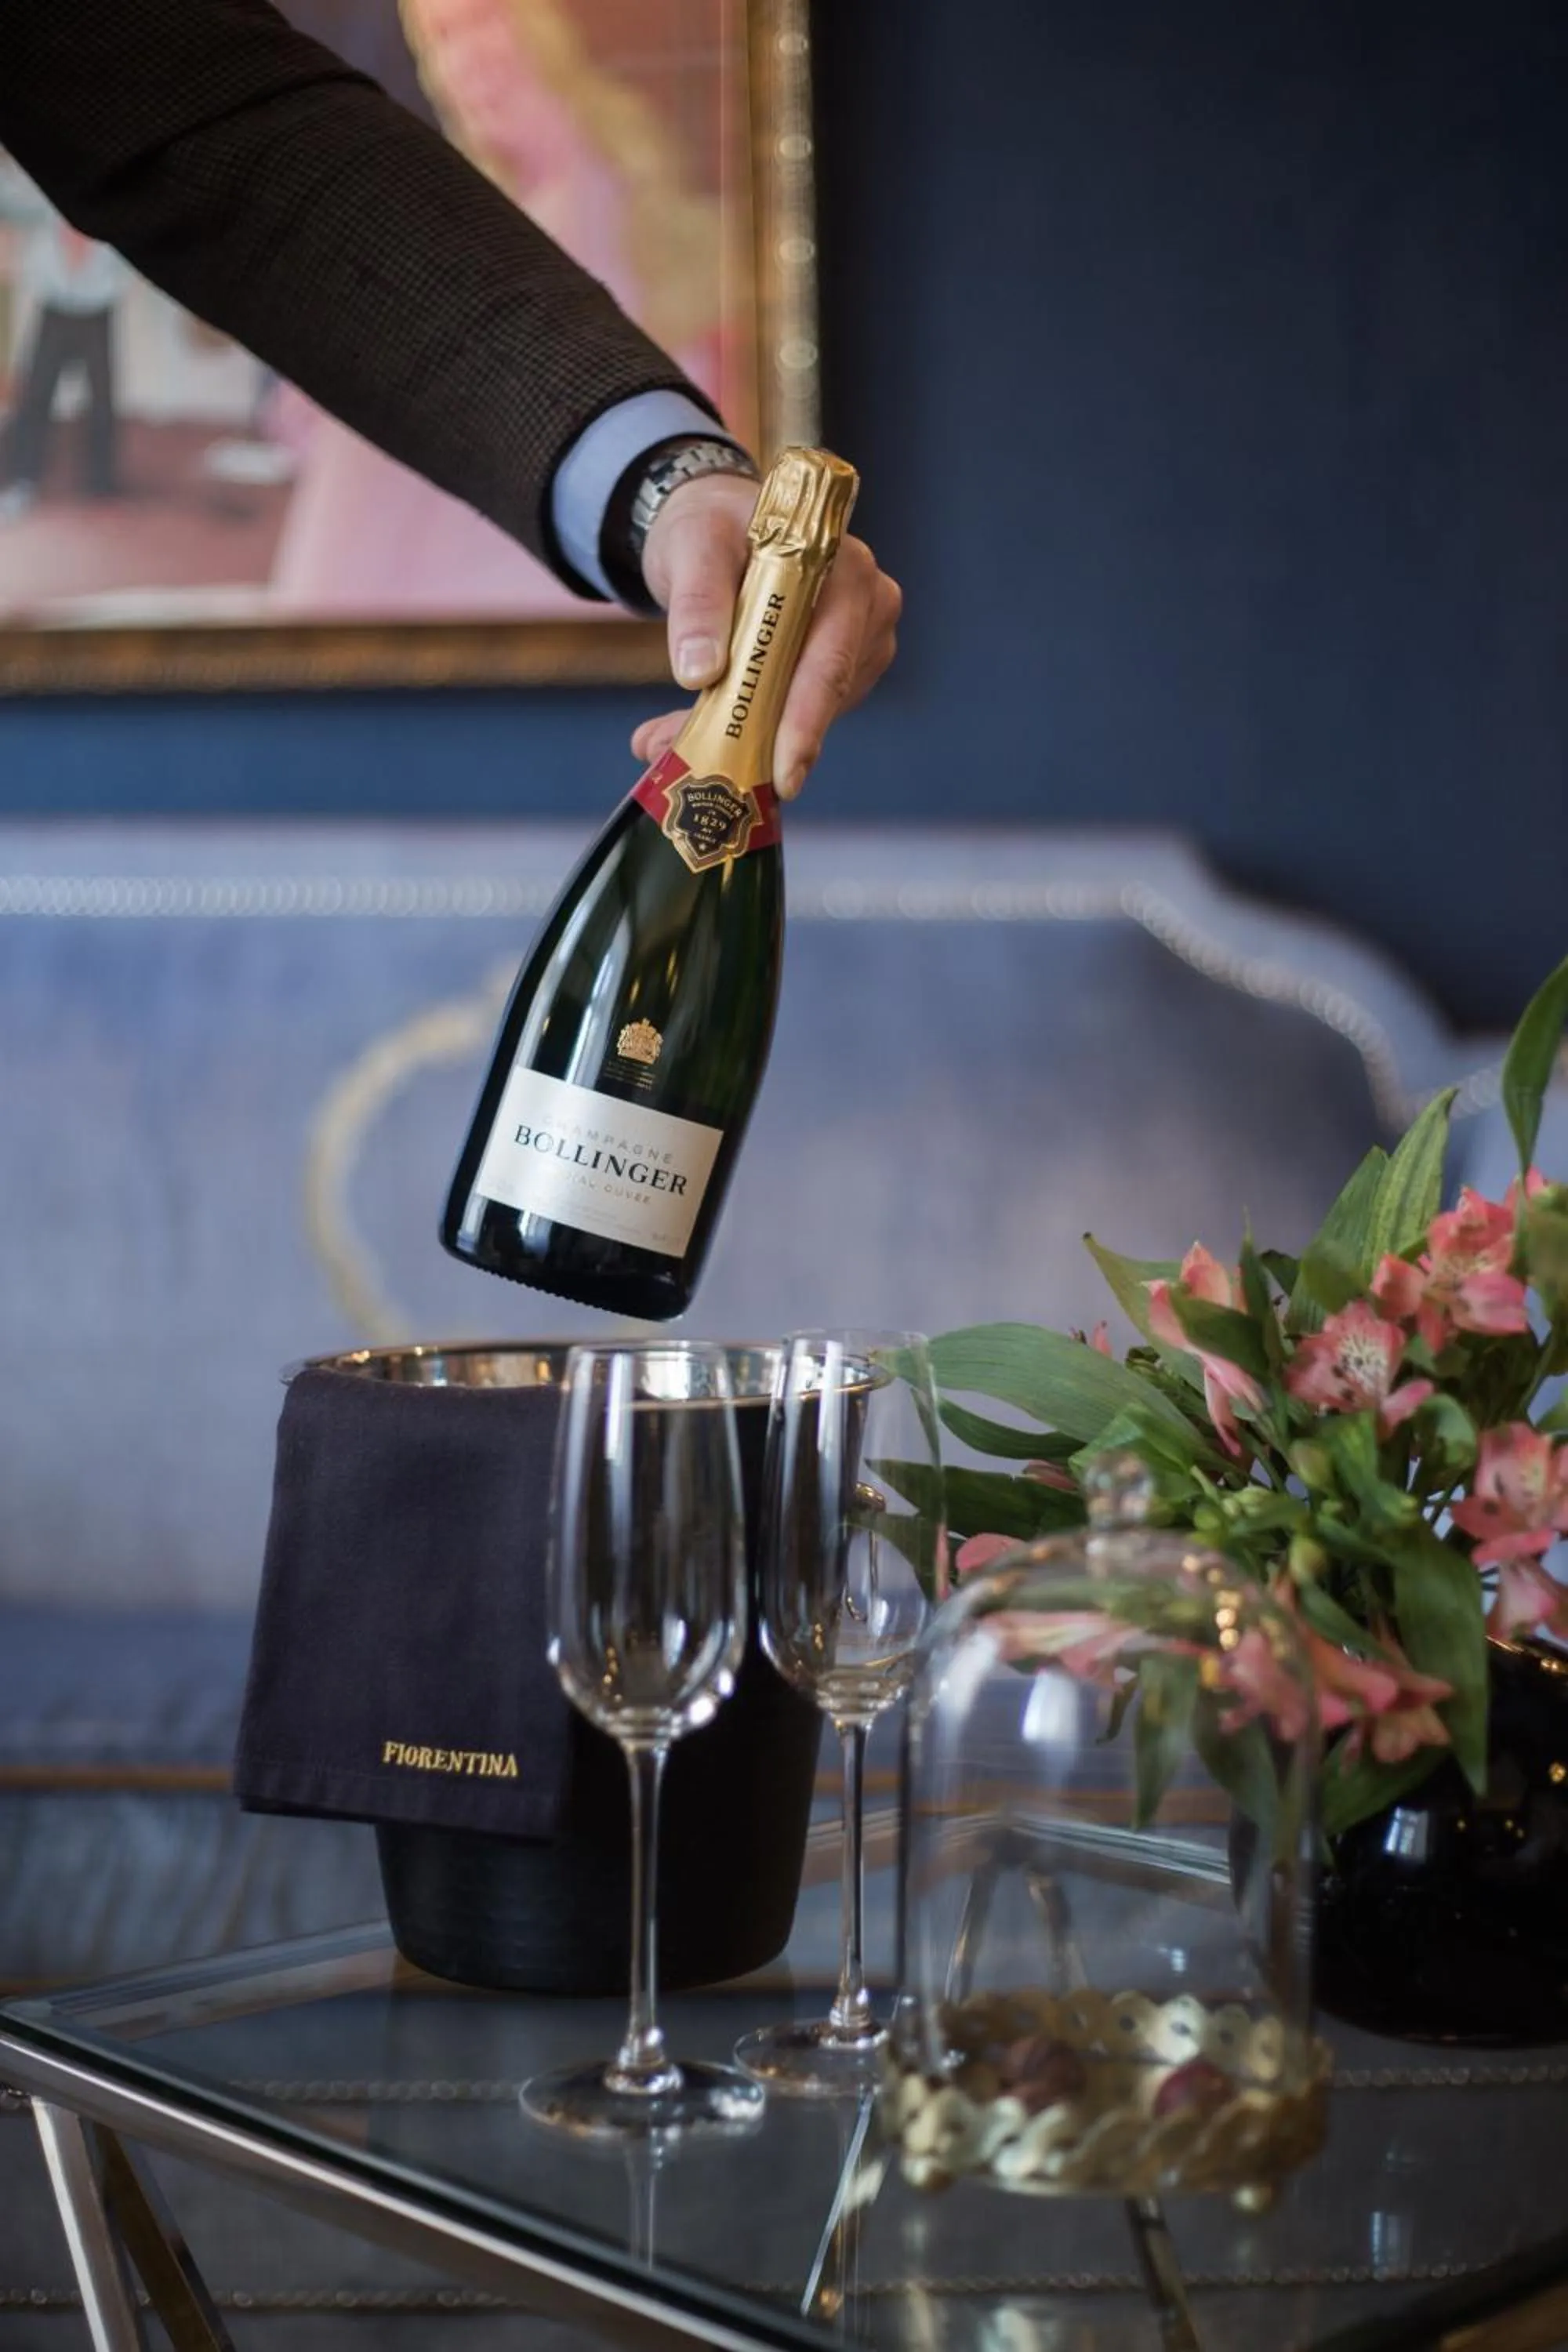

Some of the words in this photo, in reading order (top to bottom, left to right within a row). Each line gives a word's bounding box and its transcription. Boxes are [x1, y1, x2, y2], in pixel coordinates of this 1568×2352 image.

[725, 592, 786, 740] BOLLINGER
[687, 790, 743, 818] BOLLINGER
[514, 1124, 688, 1196] BOLLINGER
[382, 1740, 518, 1778] FIORENTINA
